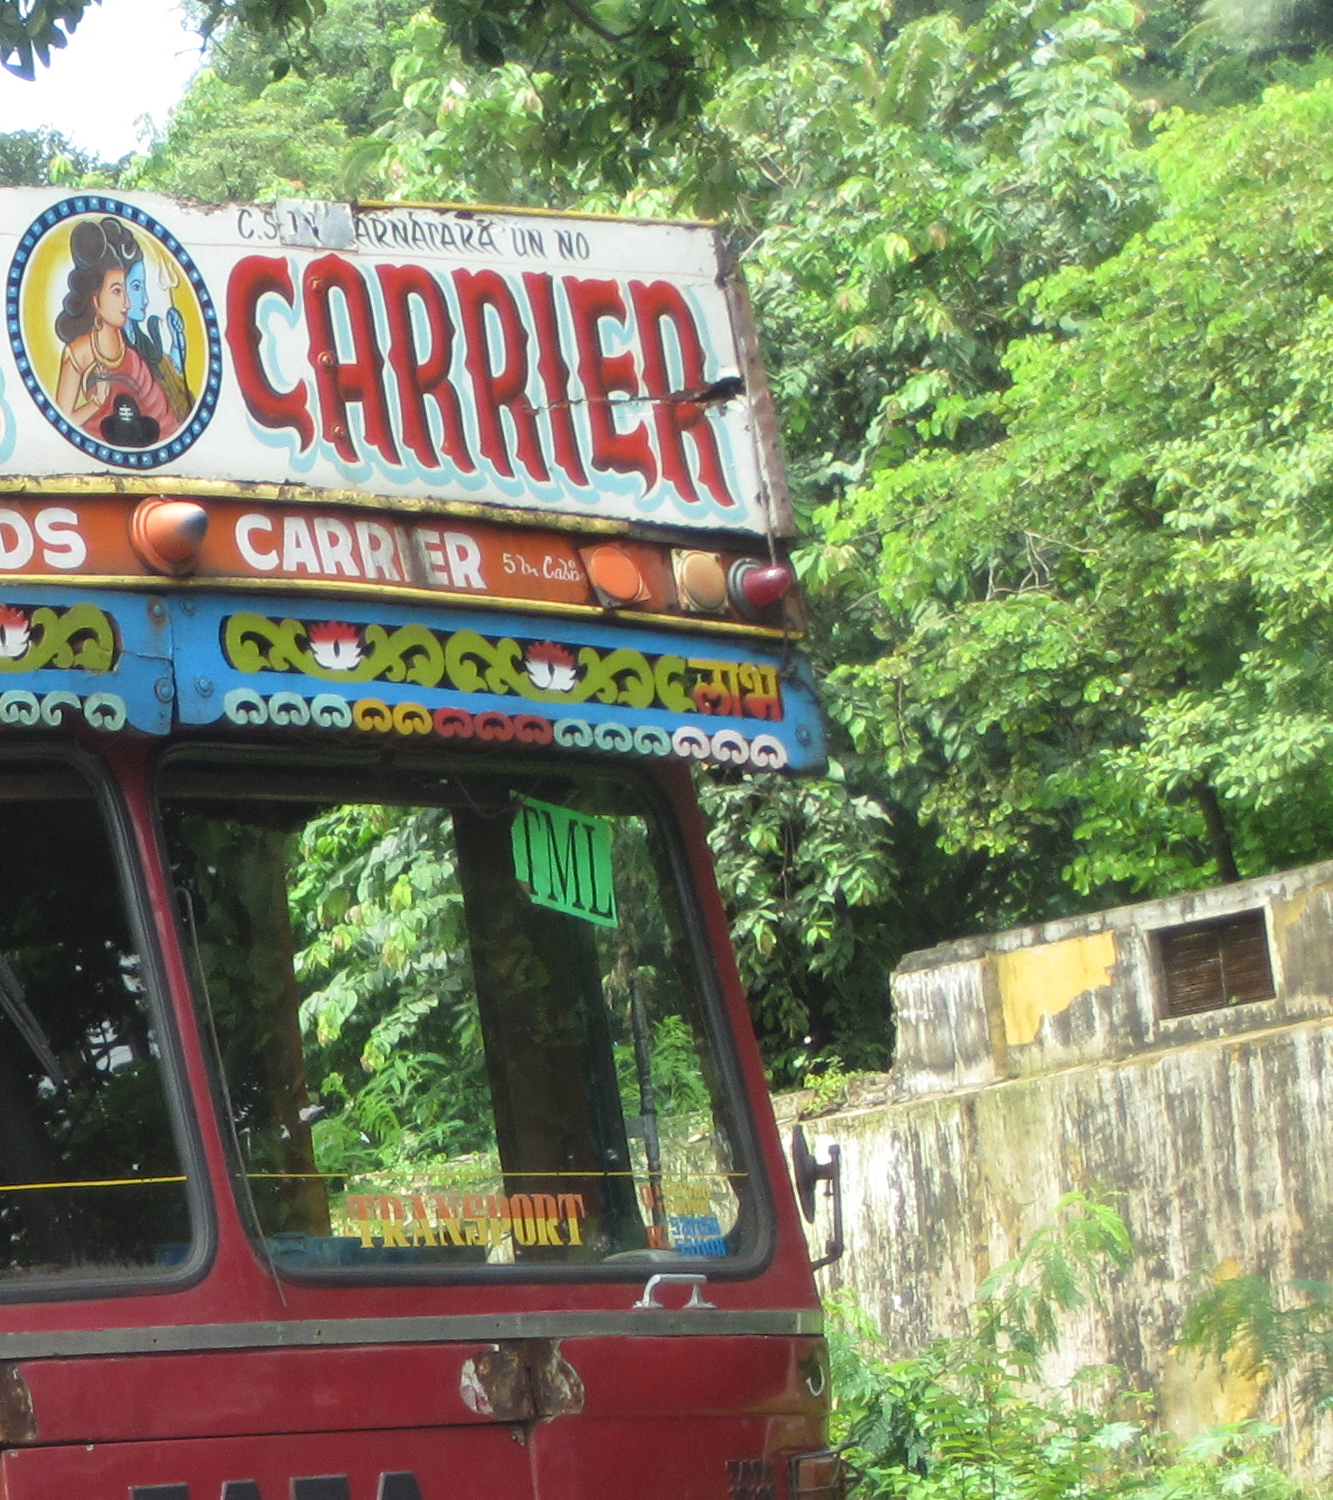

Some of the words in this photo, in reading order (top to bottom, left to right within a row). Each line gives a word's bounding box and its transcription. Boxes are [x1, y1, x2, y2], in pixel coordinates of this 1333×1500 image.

[354, 213, 503, 256] ARNATAKA
[553, 229, 590, 261] NO
[225, 254, 735, 508] CARRIER
[235, 513, 487, 590] CARRIER
[503, 553, 516, 573] 5
[688, 658, 782, 722] लाभ
[347, 1194, 585, 1248] TRANSPORT
